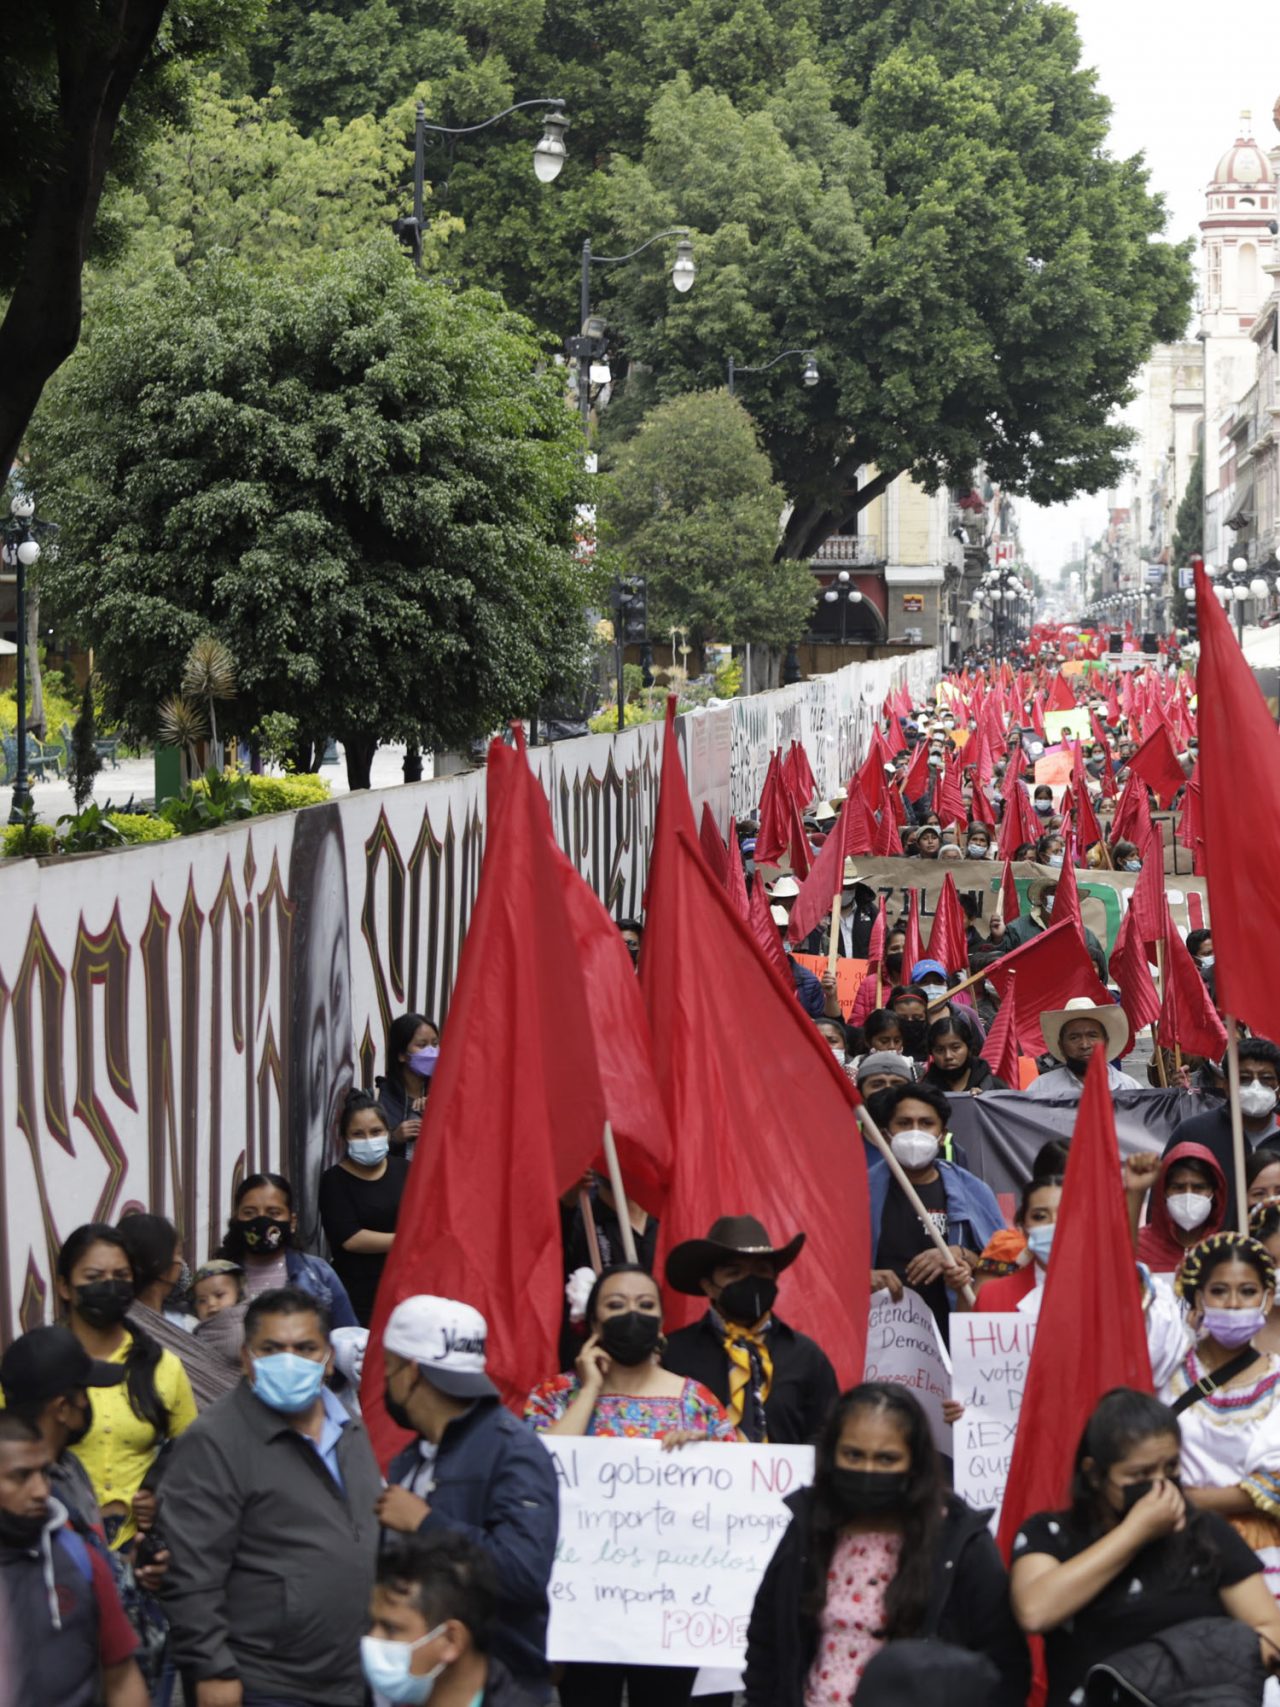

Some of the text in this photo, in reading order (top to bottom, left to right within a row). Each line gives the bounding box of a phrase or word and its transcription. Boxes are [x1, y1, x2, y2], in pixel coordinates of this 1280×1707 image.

[967, 1321, 1037, 1358] HUI
[979, 1360, 1025, 1383] votó
[964, 1386, 1024, 1411] de D
[551, 1449, 793, 1498] Al gobierno NO
[963, 1487, 1004, 1506] NUE
[578, 1500, 676, 1544] importa
[692, 1502, 711, 1532] el
[593, 1538, 642, 1568] los
[654, 1546, 763, 1578] pueblos
[594, 1578, 676, 1615] importa
[691, 1584, 715, 1606] el
[661, 1609, 753, 1649] PODE
